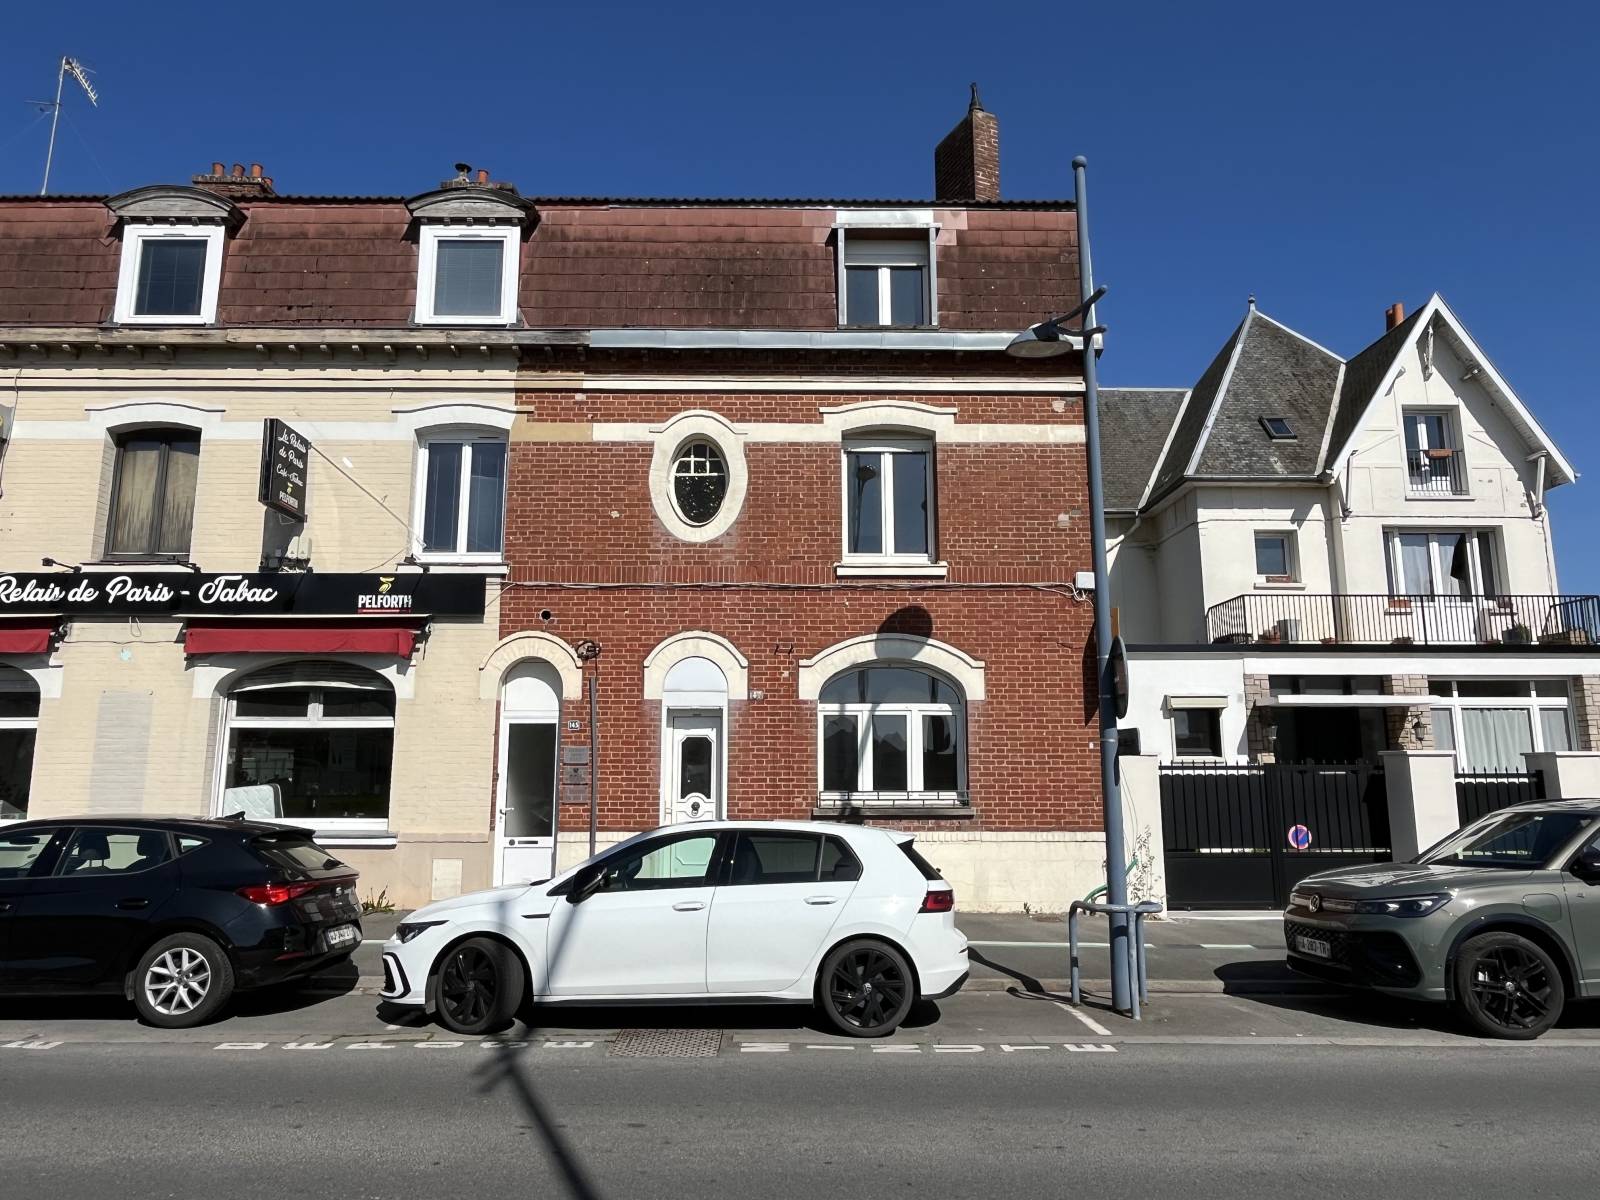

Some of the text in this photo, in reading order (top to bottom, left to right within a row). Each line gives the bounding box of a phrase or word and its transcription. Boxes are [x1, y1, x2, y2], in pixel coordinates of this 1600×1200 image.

[0, 575, 66, 603] Relais
[67, 579, 99, 602] de
[105, 575, 174, 604] Paris
[198, 575, 278, 604] Tabac
[358, 594, 412, 608] PELFORTH
